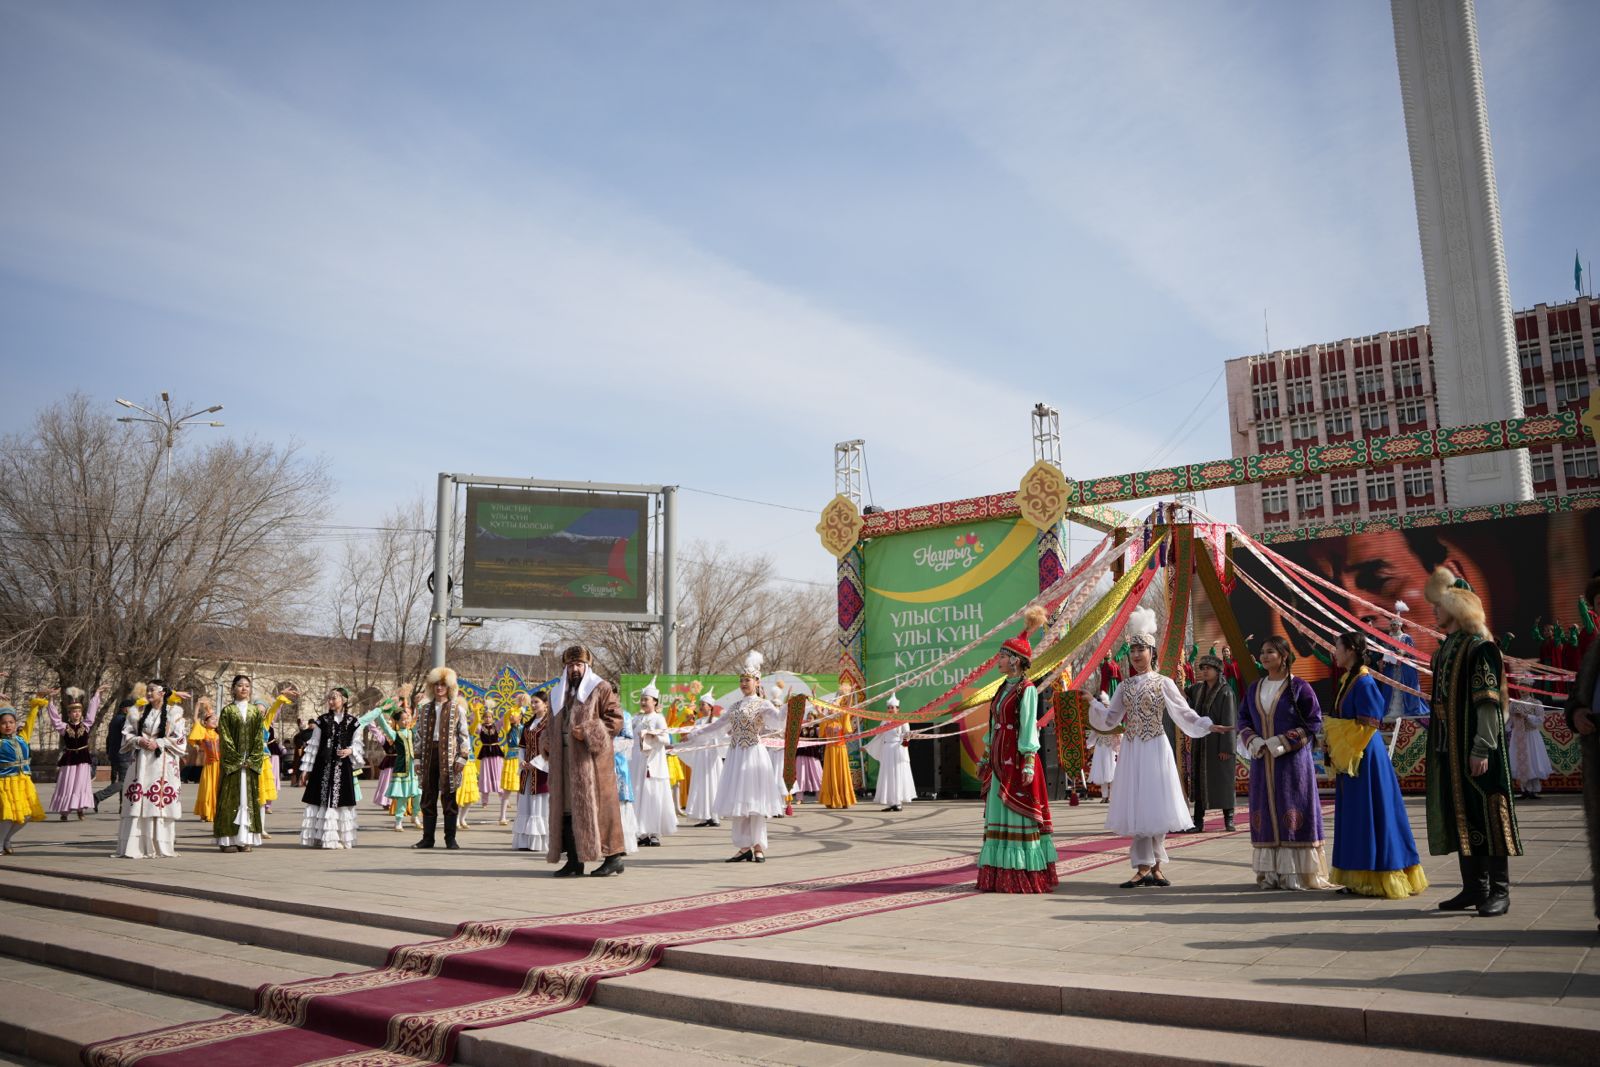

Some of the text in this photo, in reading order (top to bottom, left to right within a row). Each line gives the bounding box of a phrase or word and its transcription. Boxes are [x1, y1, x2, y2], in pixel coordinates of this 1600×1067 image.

[913, 544, 977, 572] Наурыз
[890, 602, 983, 628] ҰЛЫСТЫҢ
[892, 623, 980, 647] ҰЛЫ КҮНІ
